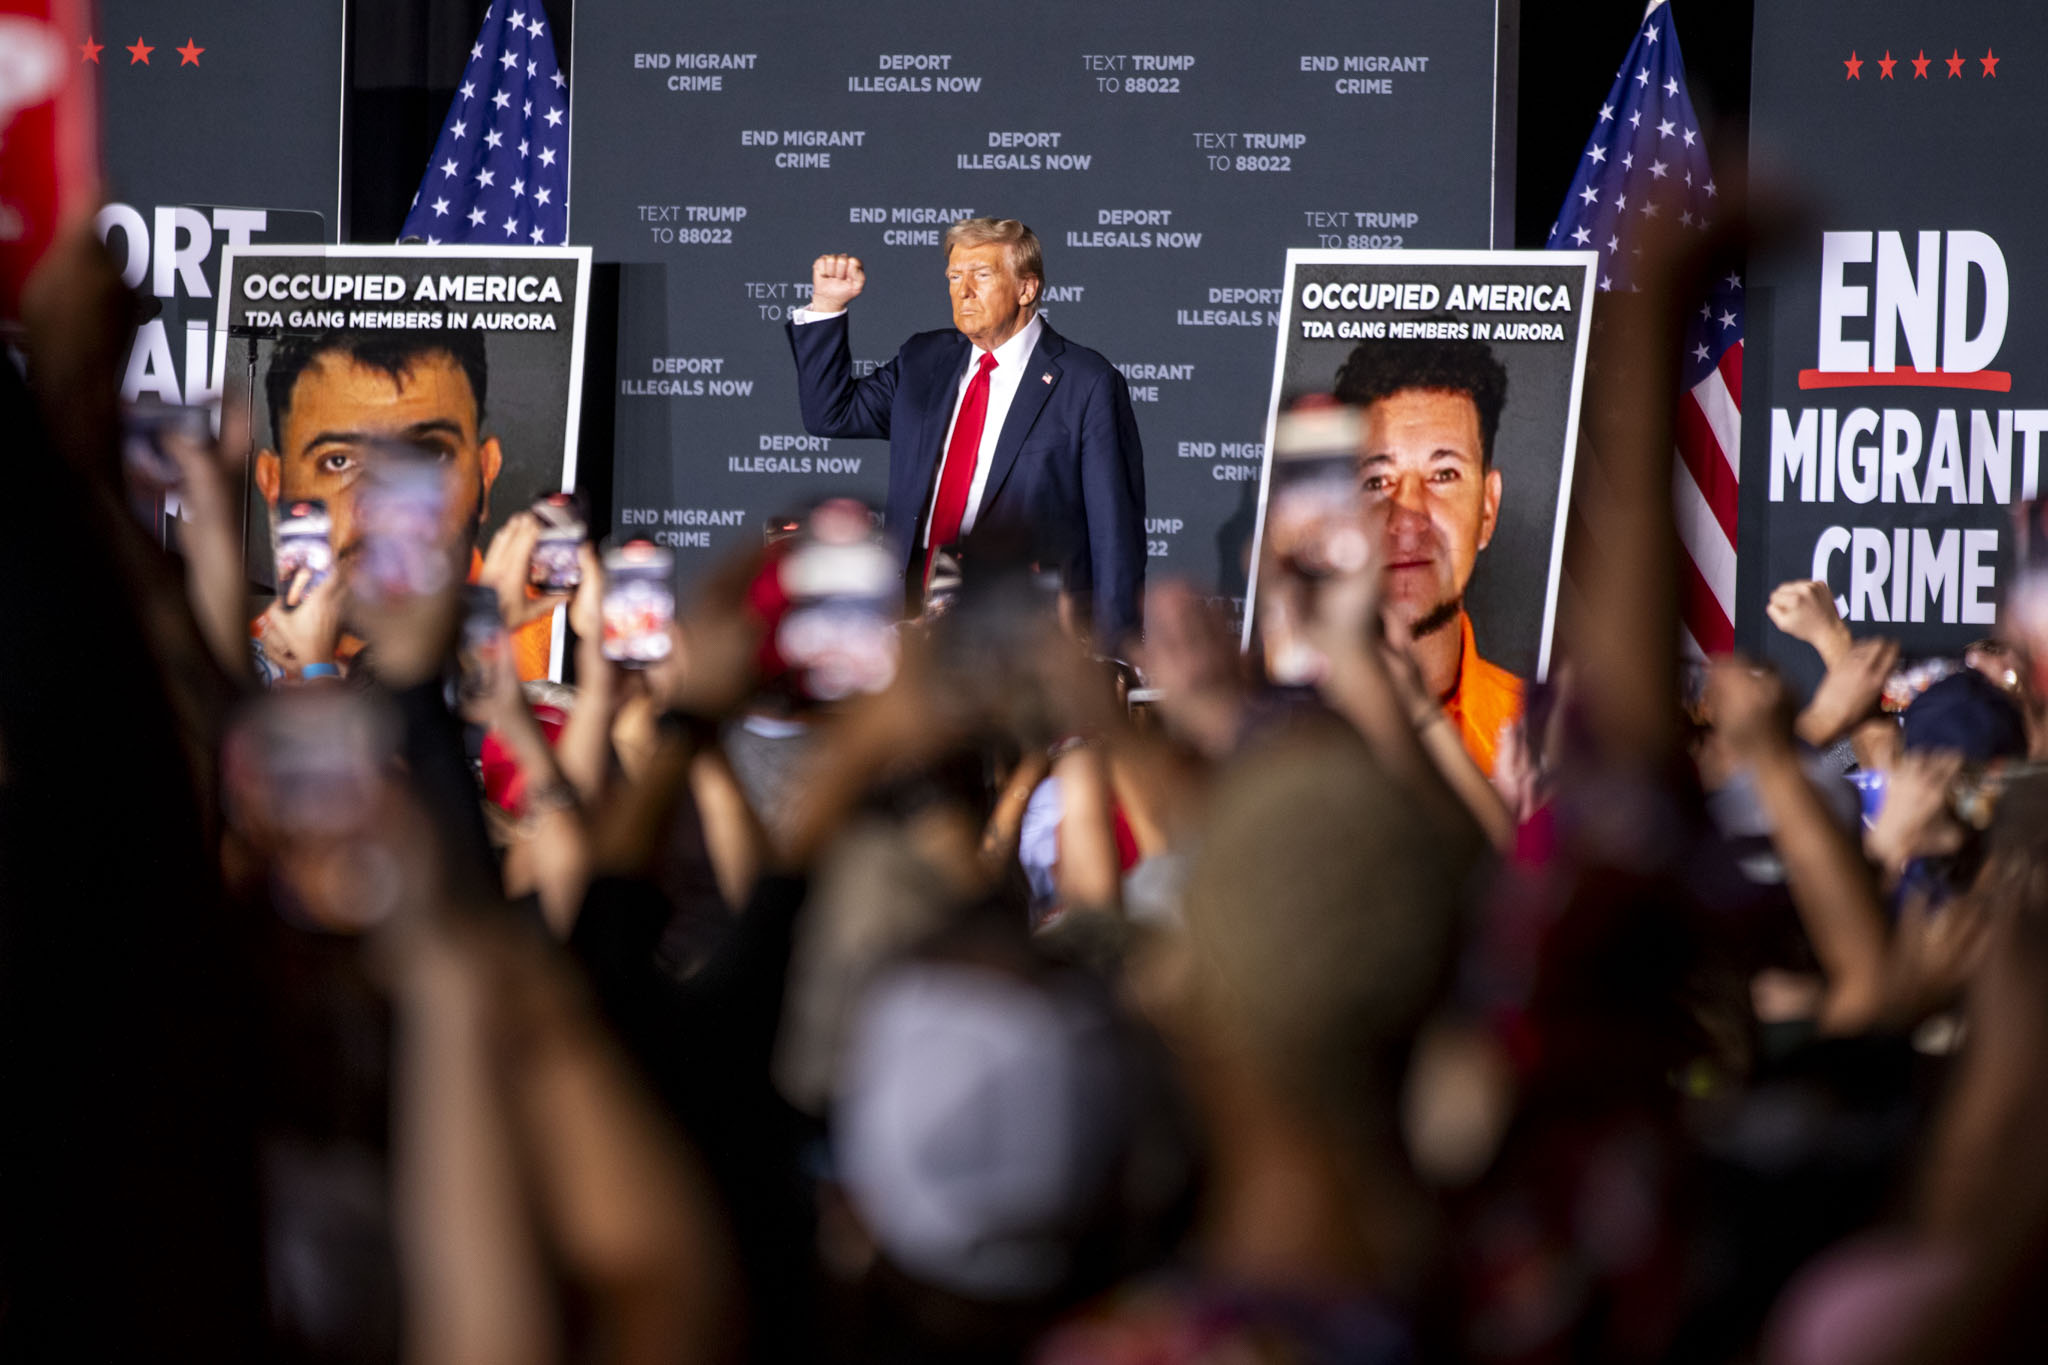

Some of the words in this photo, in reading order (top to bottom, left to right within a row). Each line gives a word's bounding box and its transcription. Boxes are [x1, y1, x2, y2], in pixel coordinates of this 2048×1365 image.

[635, 54, 670, 68] END
[676, 54, 757, 69] MIGRANT
[880, 55, 951, 70] DEPORT
[1082, 55, 1127, 70] TEXT
[1132, 55, 1195, 70] TRUMP
[1301, 56, 1339, 71] END
[1344, 56, 1429, 72] MIGRANT
[668, 76, 722, 91] CRIME
[849, 77, 931, 92] ILLEGALS
[937, 77, 981, 92] NOW
[1096, 77, 1120, 93] TO
[1125, 78, 1179, 93] 88022
[1336, 79, 1392, 94] CRIME
[742, 131, 778, 145] END
[784, 131, 865, 146] MIGRANT
[989, 132, 1061, 147] DEPORT
[1193, 133, 1237, 148] TEXT
[1243, 134, 1306, 149] TRUMP
[775, 153, 830, 168] CRIME
[958, 154, 1041, 169] ILLEGALS
[1046, 155, 1091, 170] NOW
[1207, 155, 1230, 171] TO
[1236, 156, 1291, 171] 88022
[638, 206, 680, 221] TEXT
[686, 206, 747, 222] TRUMP
[850, 208, 887, 222] END
[891, 208, 974, 224] MIGRANT
[1099, 210, 1172, 225] DEPORT
[1304, 212, 1349, 227] TEXT
[1355, 212, 1418, 228] TRUMP
[651, 228, 673, 243] TO
[679, 228, 732, 243] 88022
[884, 230, 939, 245] CRIME
[1067, 232, 1151, 247] ILLEGALS
[1157, 233, 1202, 248] NOW
[1318, 234, 1342, 248] TO
[1347, 235, 1403, 248] 88022
[95, 203, 266, 297] ORT
[244, 274, 406, 300] OCCUPIED
[414, 276, 562, 302] AMERICA
[745, 283, 788, 298] TEXT
[1209, 288, 1282, 304] DEPORT
[1302, 283, 1439, 309] OCCUPIED
[1445, 285, 1571, 311] AMERICA
[1818, 230, 2010, 373] END
[245, 311, 283, 327] TDA
[289, 311, 344, 328] GANG
[349, 312, 442, 328] MEMBERS
[447, 312, 468, 329] IN
[472, 313, 556, 330] AURORA
[758, 305, 781, 320] TO
[1178, 310, 1262, 326] ILLEGALS
[1302, 321, 1334, 337] TDA
[1338, 322, 1385, 338] GANG
[1389, 322, 1469, 339] MEMBERS
[1472, 323, 1490, 339] IN
[1493, 323, 1564, 340] AURORA
[653, 358, 724, 373] DEPORT
[623, 380, 704, 396] ILLEGALS
[709, 381, 753, 396] NOW
[760, 435, 831, 451] DEPORT
[1178, 442, 1216, 457] END
[1220, 443, 1265, 458] MIGR
[1769, 408, 2048, 504] MIGRANT
[729, 457, 811, 473] ILLEGALS
[817, 458, 861, 473] NOW
[1212, 465, 1263, 481] CRIM
[622, 509, 658, 524] END
[664, 510, 745, 525] MIGRANT
[1145, 519, 1183, 534] UMP
[655, 530, 710, 547] CRIME
[1812, 526, 1999, 624] CRIME
